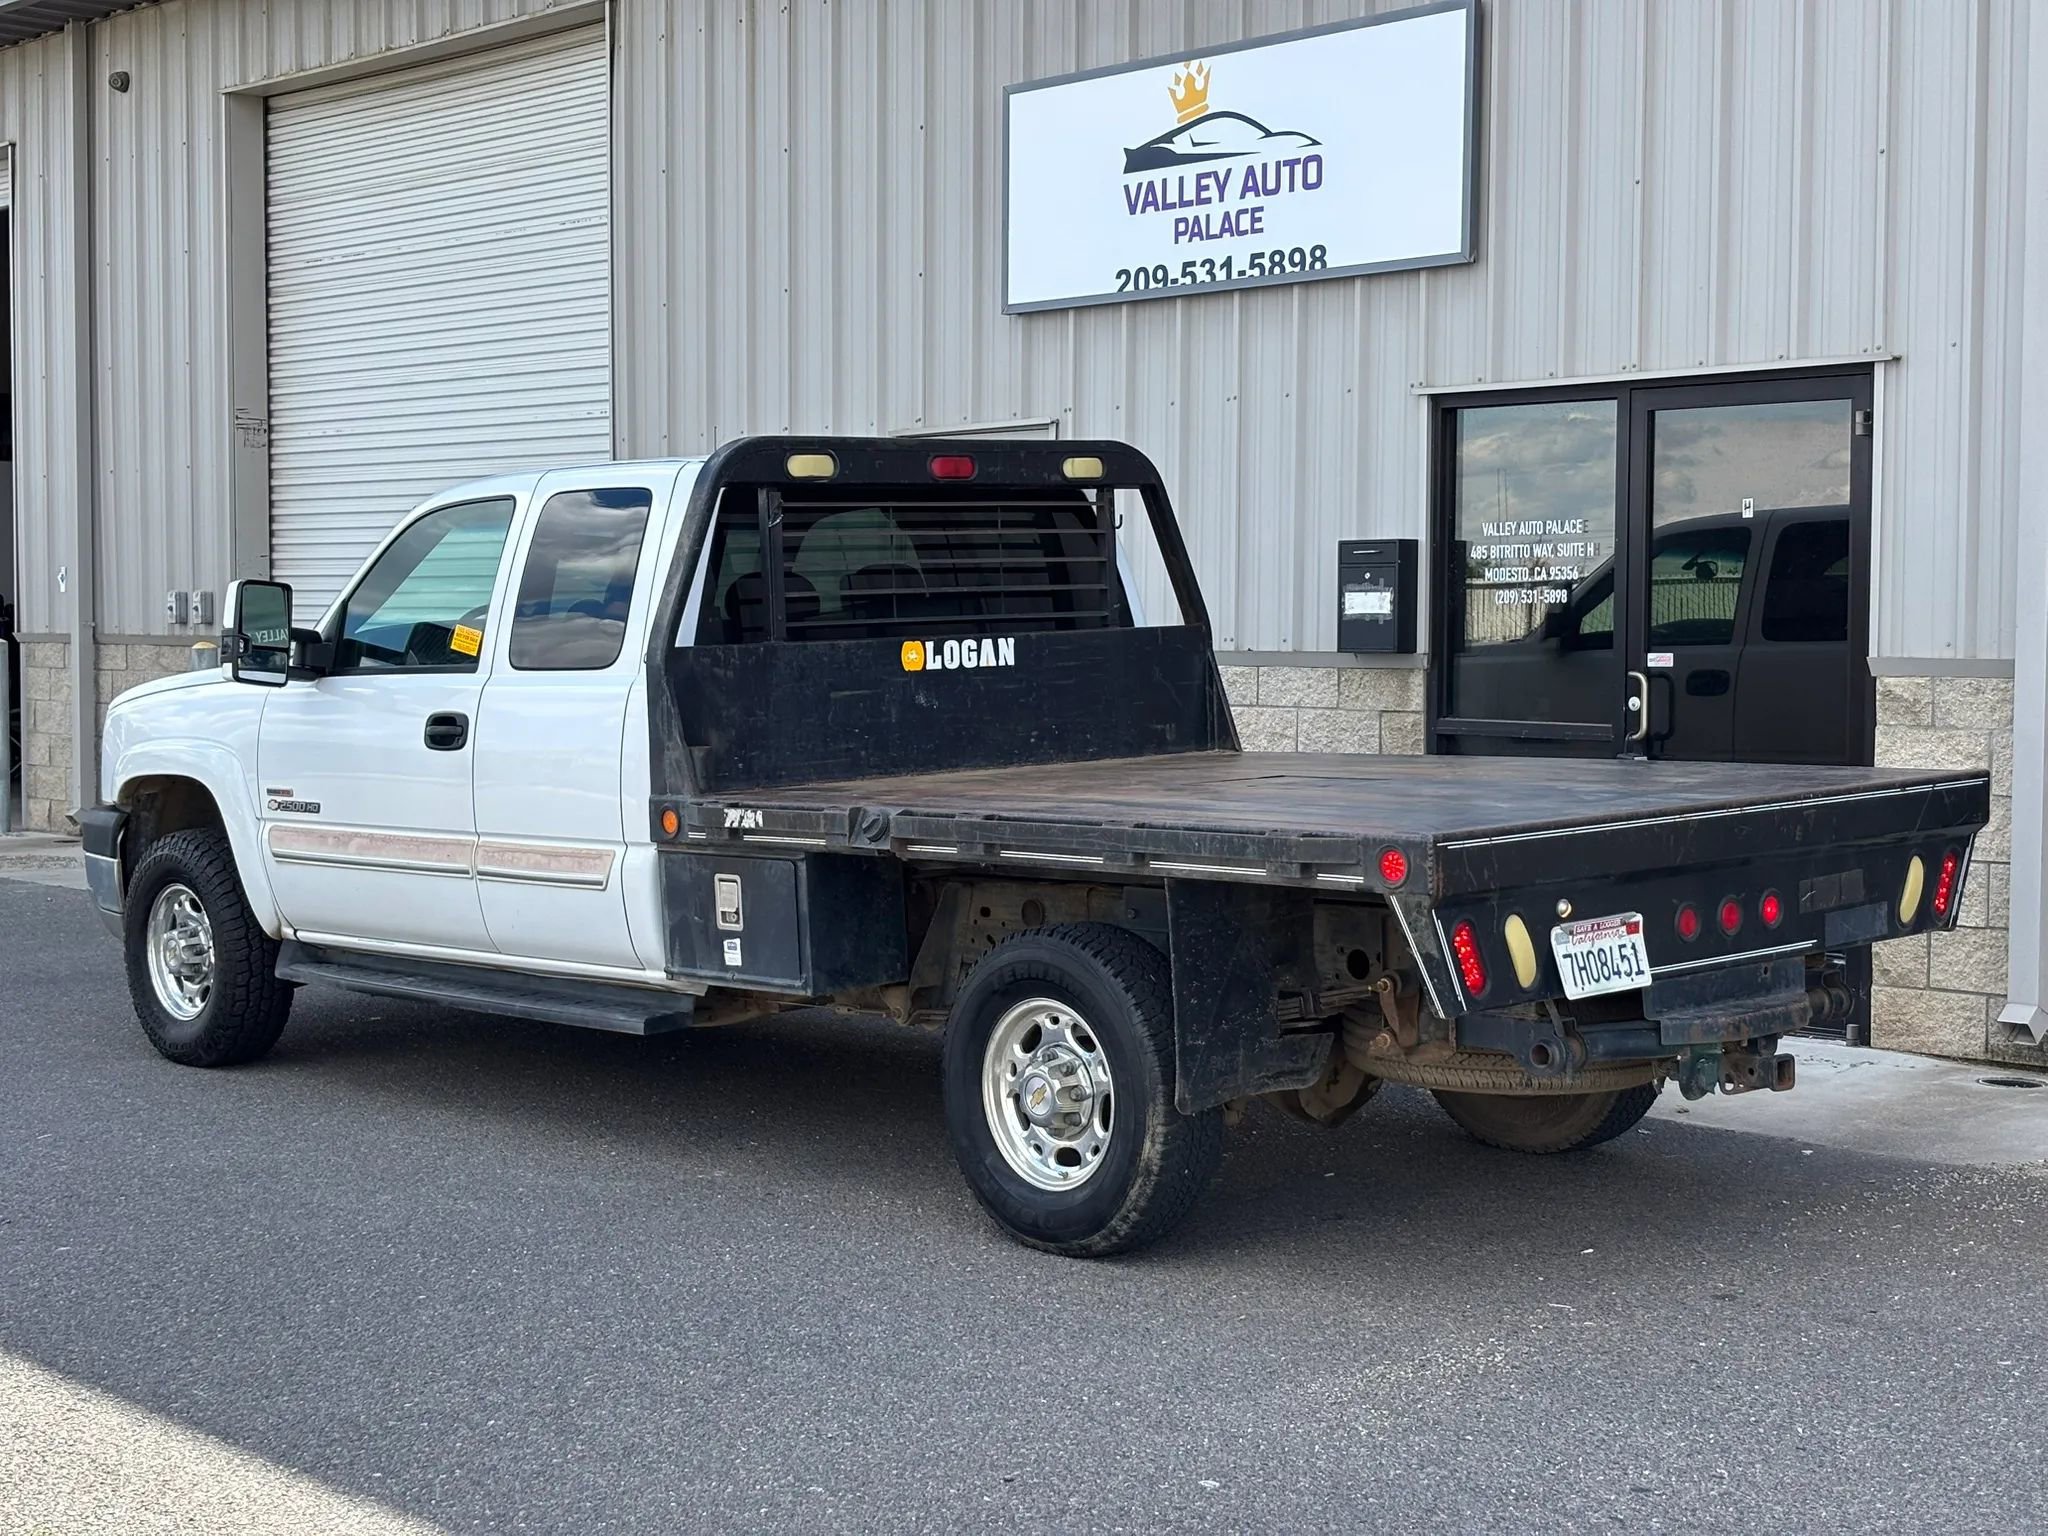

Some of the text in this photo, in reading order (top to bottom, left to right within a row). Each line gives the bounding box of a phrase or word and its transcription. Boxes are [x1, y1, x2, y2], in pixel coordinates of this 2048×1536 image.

[1123, 154, 1323, 215] VALLEY AUTO
[1174, 206, 1264, 244] PALACE
[1115, 244, 1327, 293] 209-531-5898
[1482, 519, 1583, 536] VALLEY AUTO PALACE
[1470, 545, 1488, 559] 485
[1490, 544, 1531, 559] BITRITTO
[1557, 542, 1585, 557] SUITE
[1587, 542, 1594, 556] H
[1534, 566, 1547, 581] CA
[1549, 566, 1579, 580] 95356
[1495, 589, 1568, 605] (209) 531-5898
[925, 637, 1015, 670] LOGAN
[280, 800, 306, 811] 2500
[1562, 942, 1645, 988] 7H08451
